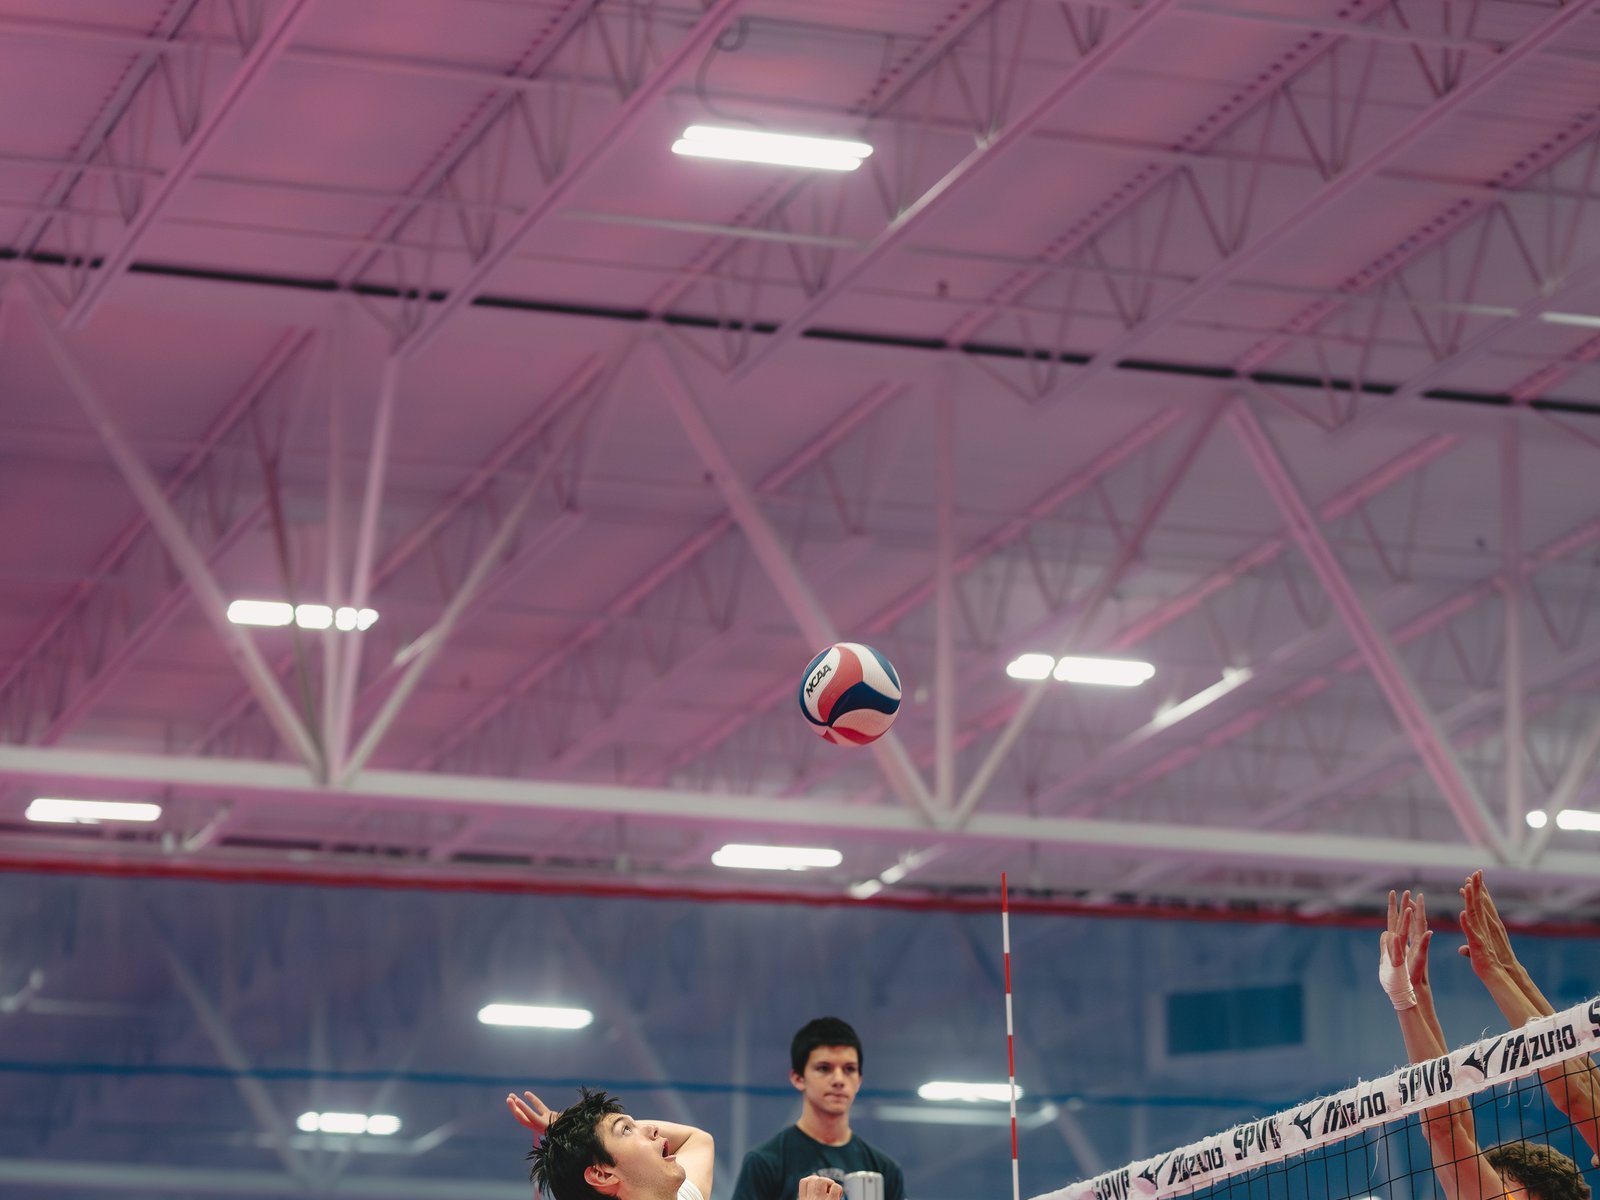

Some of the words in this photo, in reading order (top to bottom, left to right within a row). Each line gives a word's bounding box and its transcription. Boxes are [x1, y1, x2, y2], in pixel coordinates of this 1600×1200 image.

[805, 663, 832, 698] NCAA
[1397, 1056, 1453, 1106] SPVB
[1500, 1024, 1577, 1074] Mzuno
